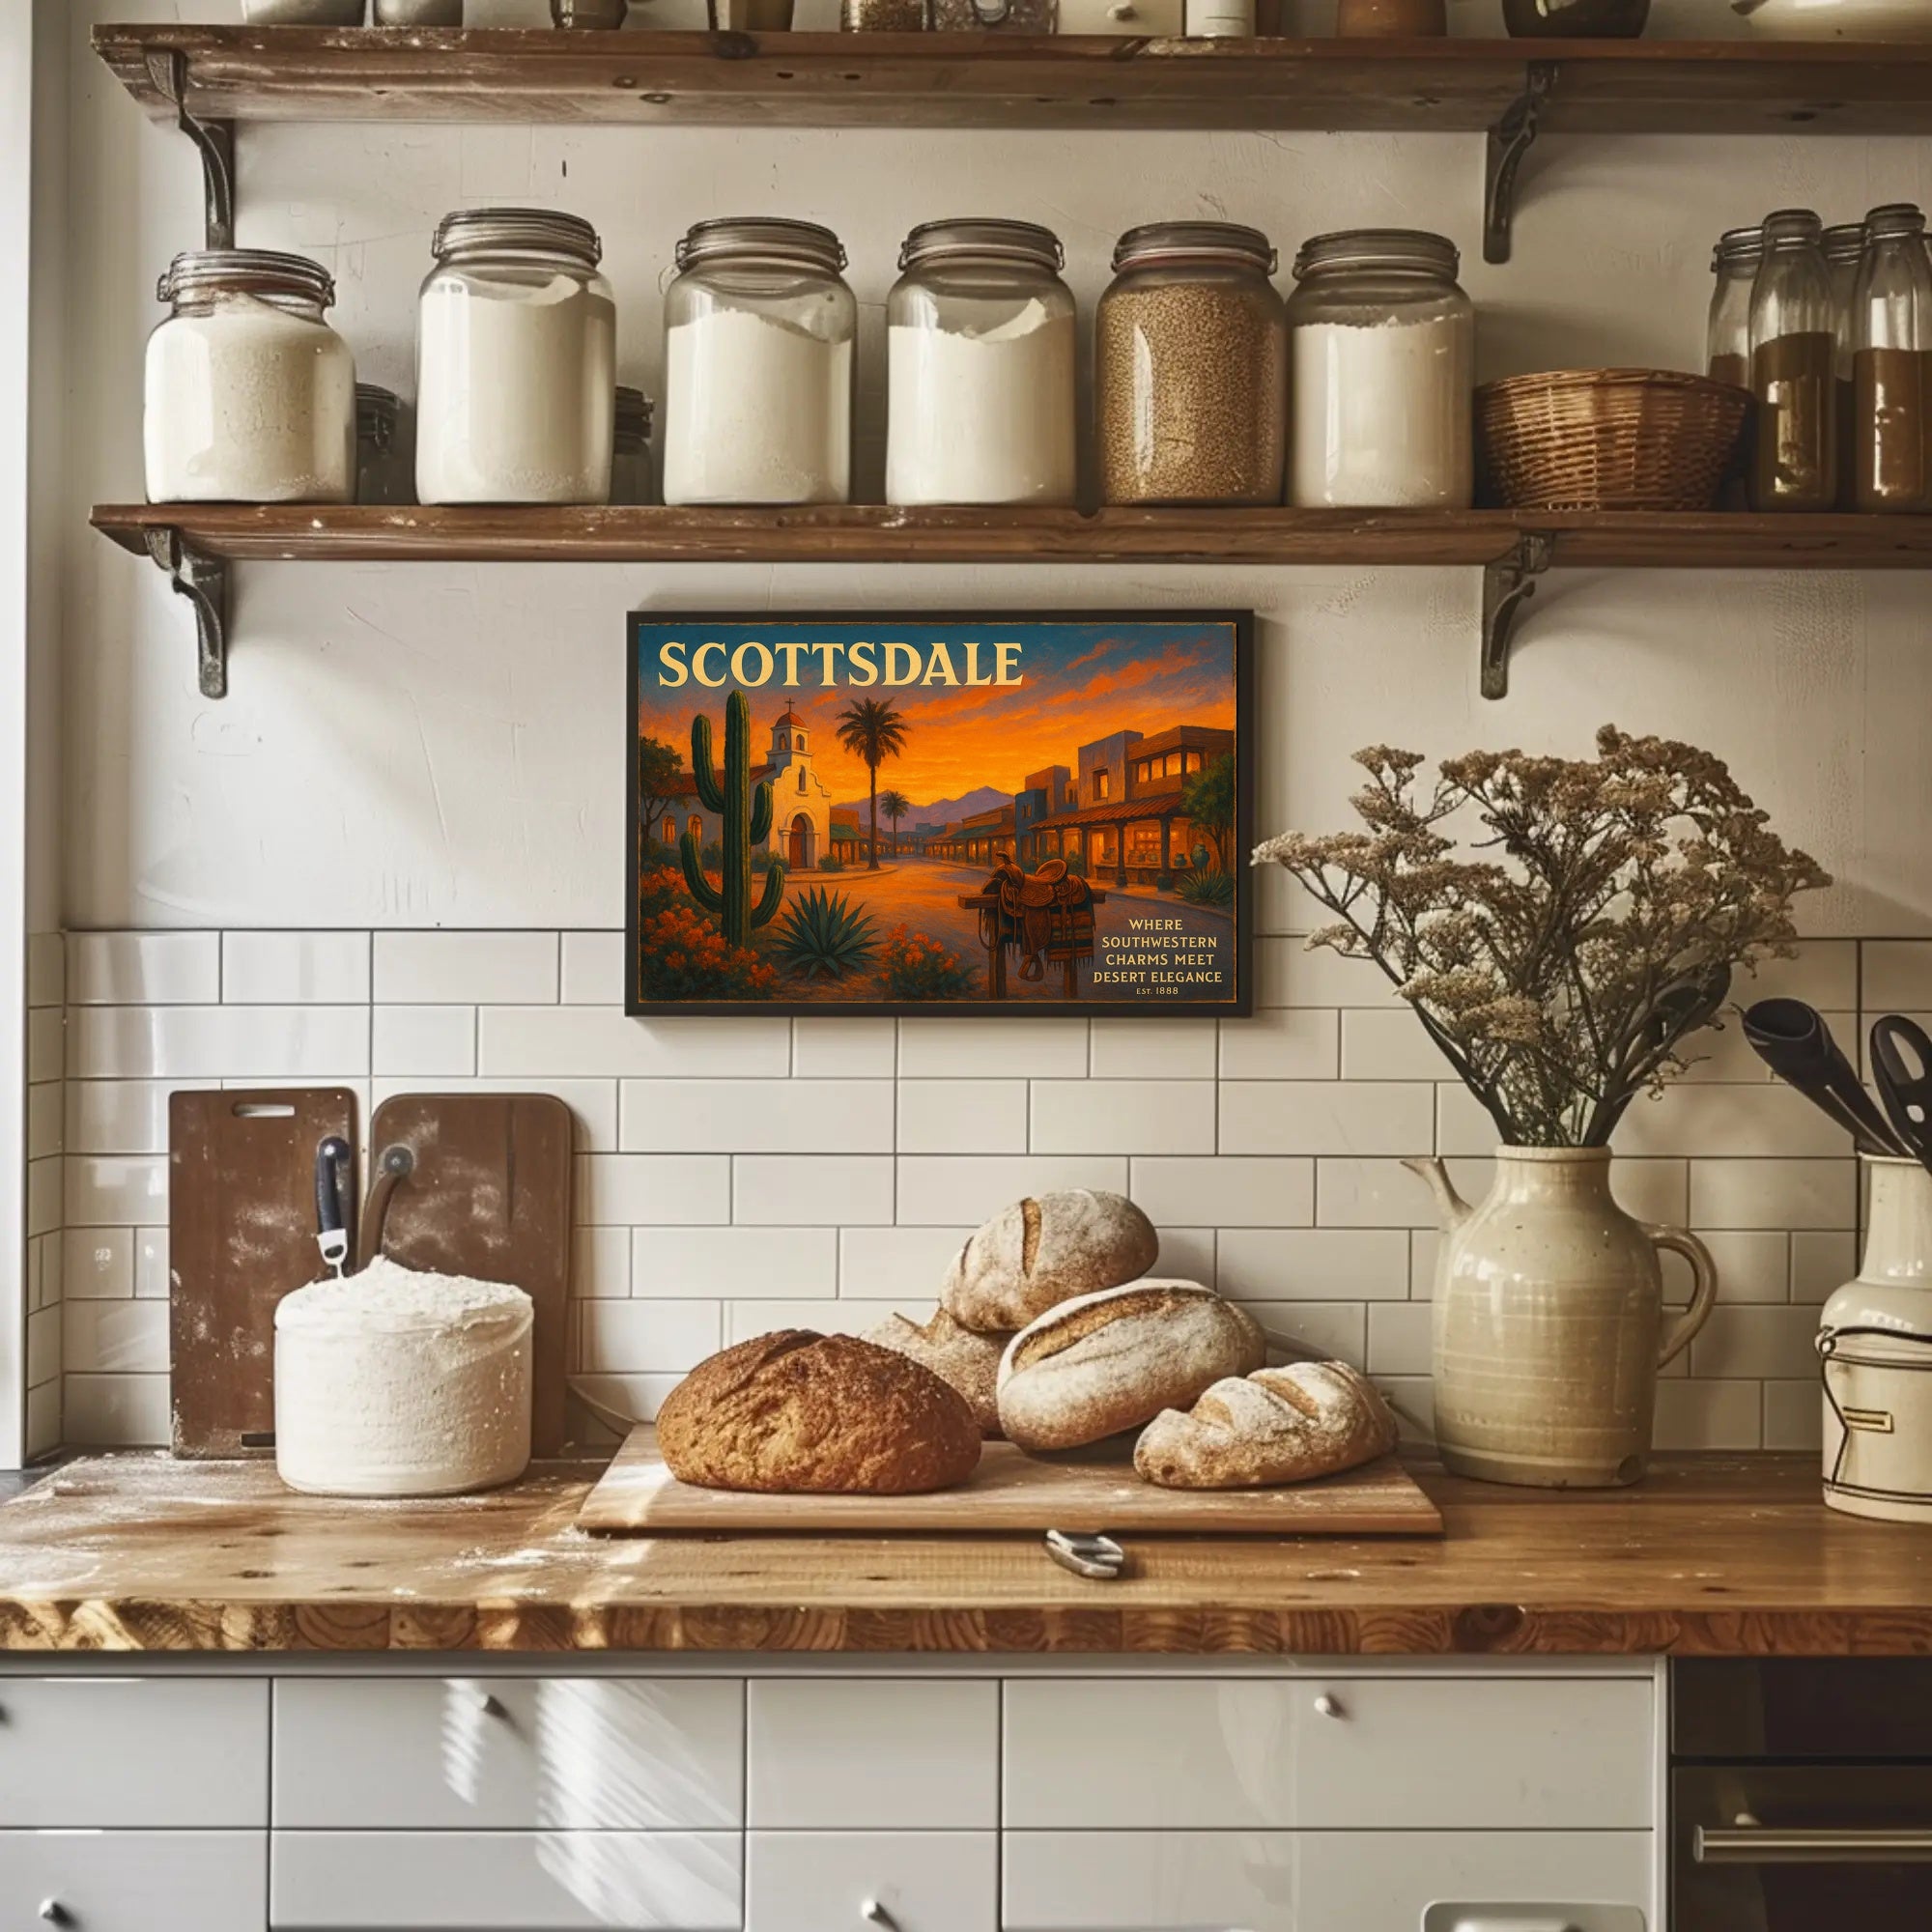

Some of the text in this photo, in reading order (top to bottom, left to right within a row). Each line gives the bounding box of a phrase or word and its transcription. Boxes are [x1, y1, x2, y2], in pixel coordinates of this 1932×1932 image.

[658, 641, 1024, 688] SCOTTSDALE
[1128, 919, 1183, 930] WHERE
[1101, 936, 1217, 949] SOUTHWESTERN
[1105, 953, 1214, 966] CHARMS MEET
[1093, 971, 1223, 983] DESERT ELEGANCE
[1155, 986, 1179, 995] 1888
